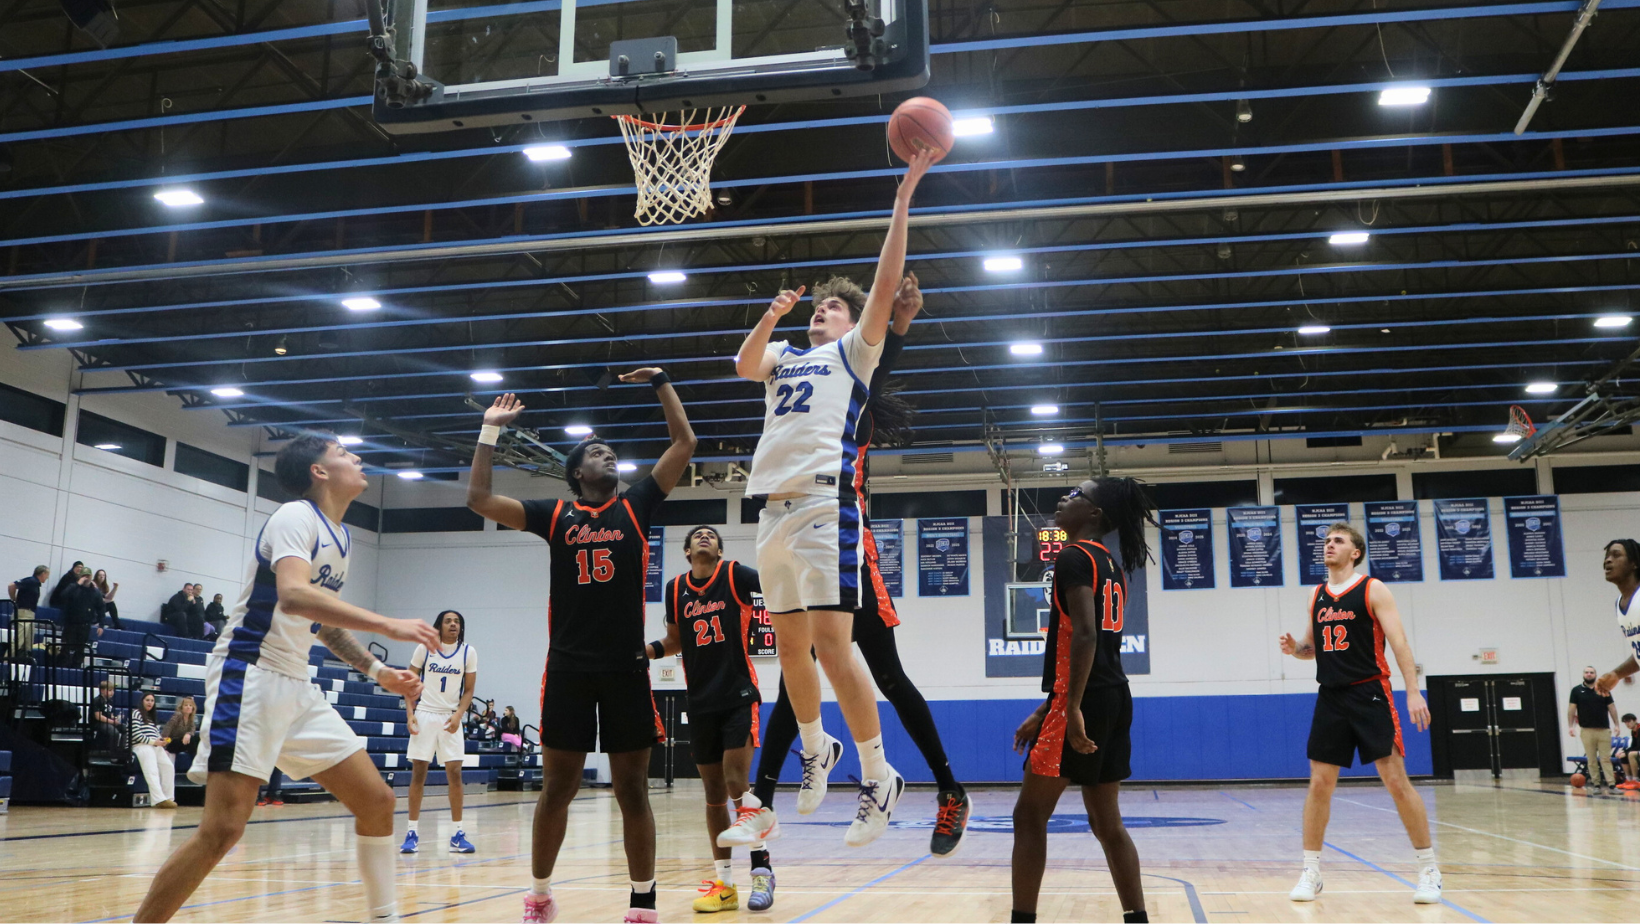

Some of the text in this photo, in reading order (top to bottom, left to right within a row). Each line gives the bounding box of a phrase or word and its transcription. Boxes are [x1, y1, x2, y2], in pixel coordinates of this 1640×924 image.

[770, 362, 831, 385] Raiders
[774, 381, 814, 416] 22
[565, 524, 624, 545] Clinton
[1039, 530, 1067, 541] 18:38
[576, 548, 615, 584] 15
[684, 600, 725, 618] Clinton
[1317, 606, 1356, 623] Clinton
[693, 615, 725, 647] 21
[764, 633, 773, 646] 0
[1322, 625, 1350, 652] 12
[989, 639, 1046, 656] RAID
[1484, 652, 1496, 660] EXIT
[428, 663, 461, 674] Raiders
[440, 676, 447, 692] 1
